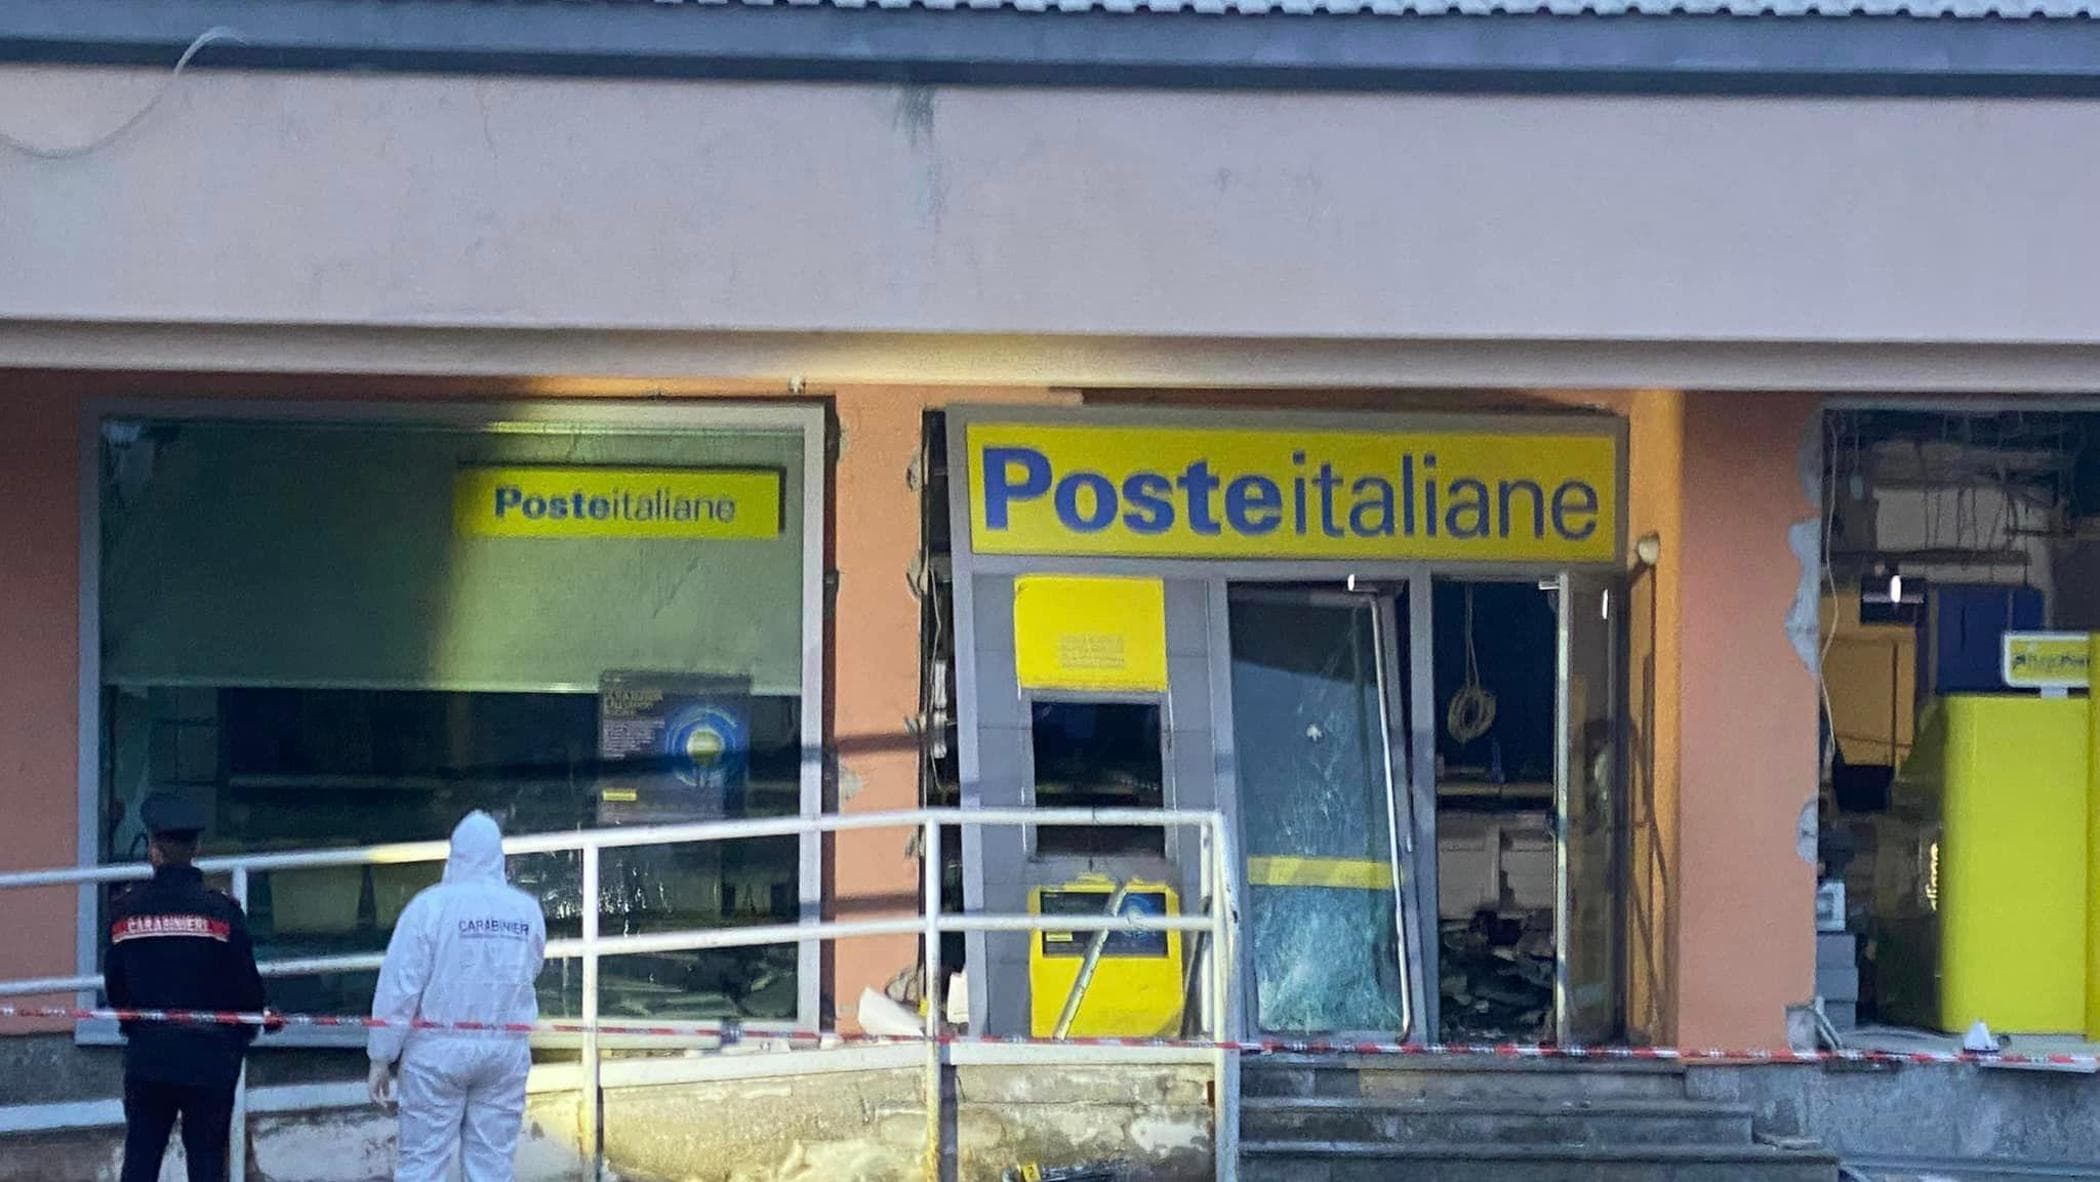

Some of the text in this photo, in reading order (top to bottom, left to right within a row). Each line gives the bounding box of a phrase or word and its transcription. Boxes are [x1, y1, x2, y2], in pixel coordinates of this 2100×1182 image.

[494, 485, 735, 523] Posteitaliane
[983, 446, 1598, 541] Posteitaliane
[127, 914, 209, 933] CARABINIERI
